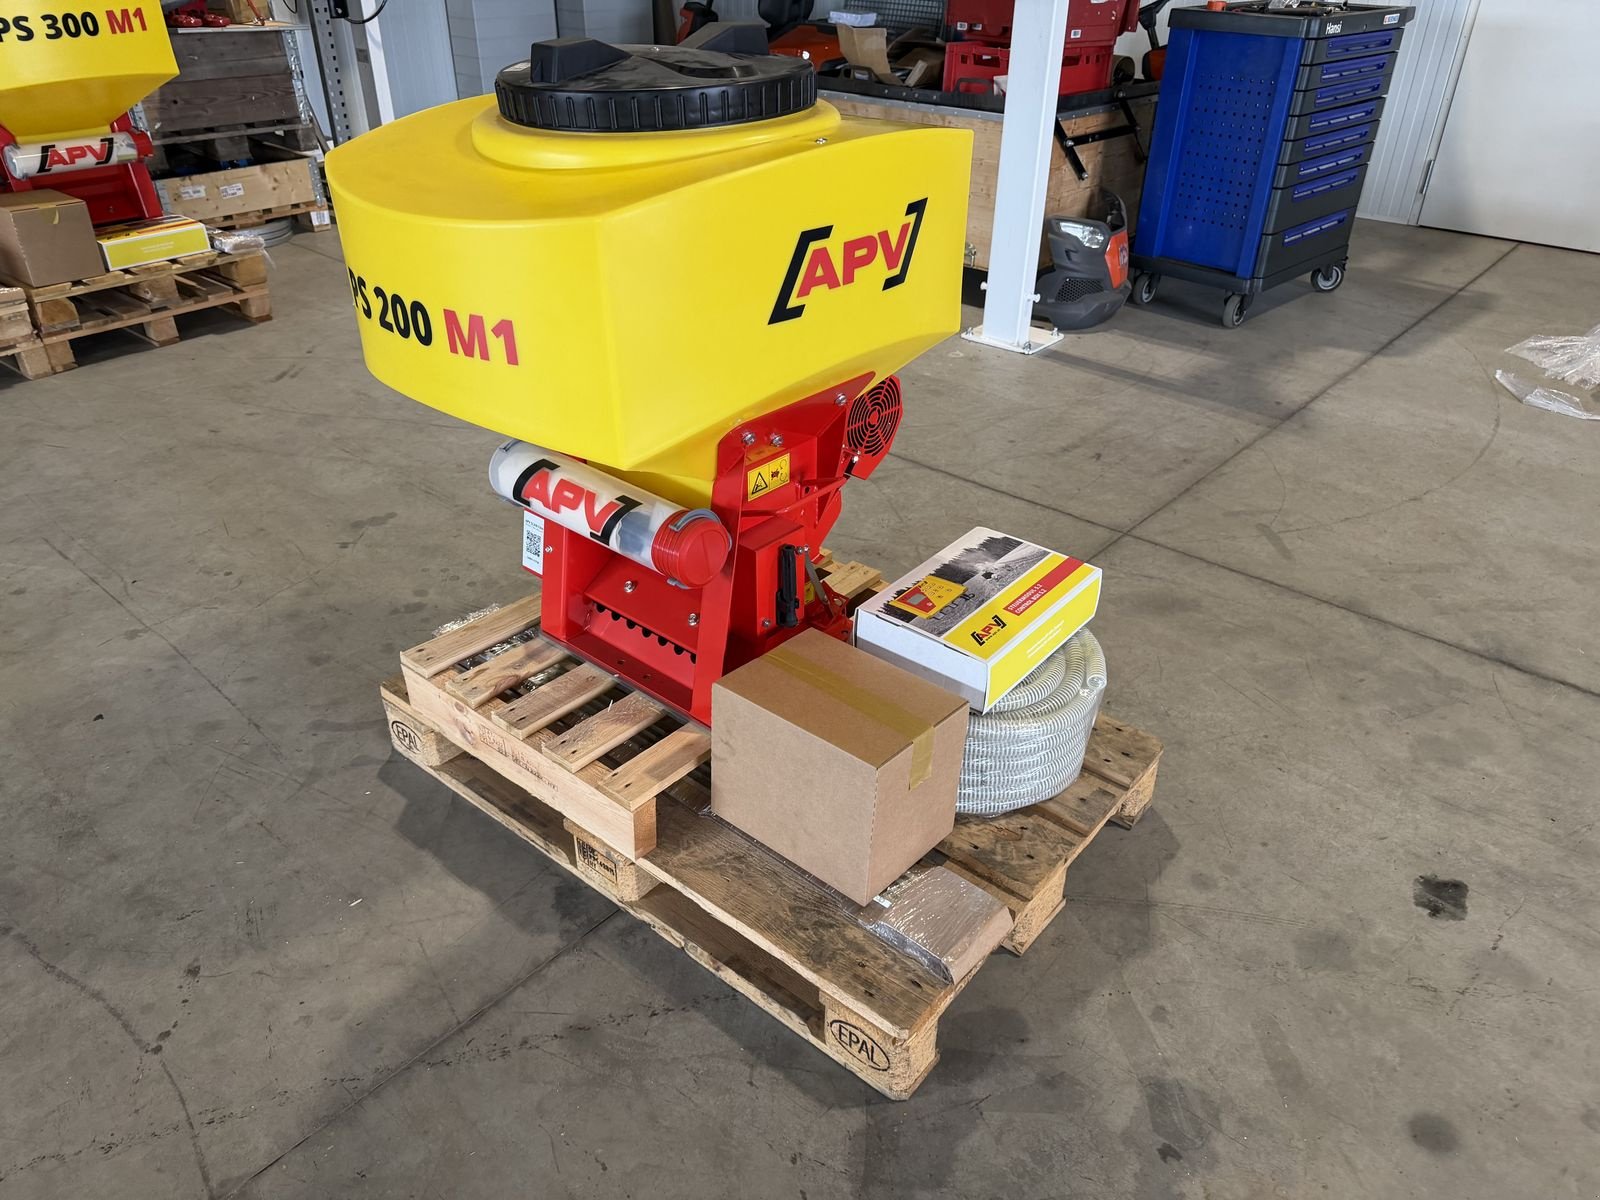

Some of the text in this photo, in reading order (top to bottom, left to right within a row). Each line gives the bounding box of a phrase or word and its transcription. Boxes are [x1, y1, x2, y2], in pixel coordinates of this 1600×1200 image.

[40, 11, 99, 40] 300
[105, 7, 147, 35] M1
[1325, 20, 1343, 35] Hansi
[373, 286, 433, 347] 200
[443, 308, 519, 366] M1
[396, 723, 421, 752] EPAL
[839, 1023, 881, 1068] EPAL
